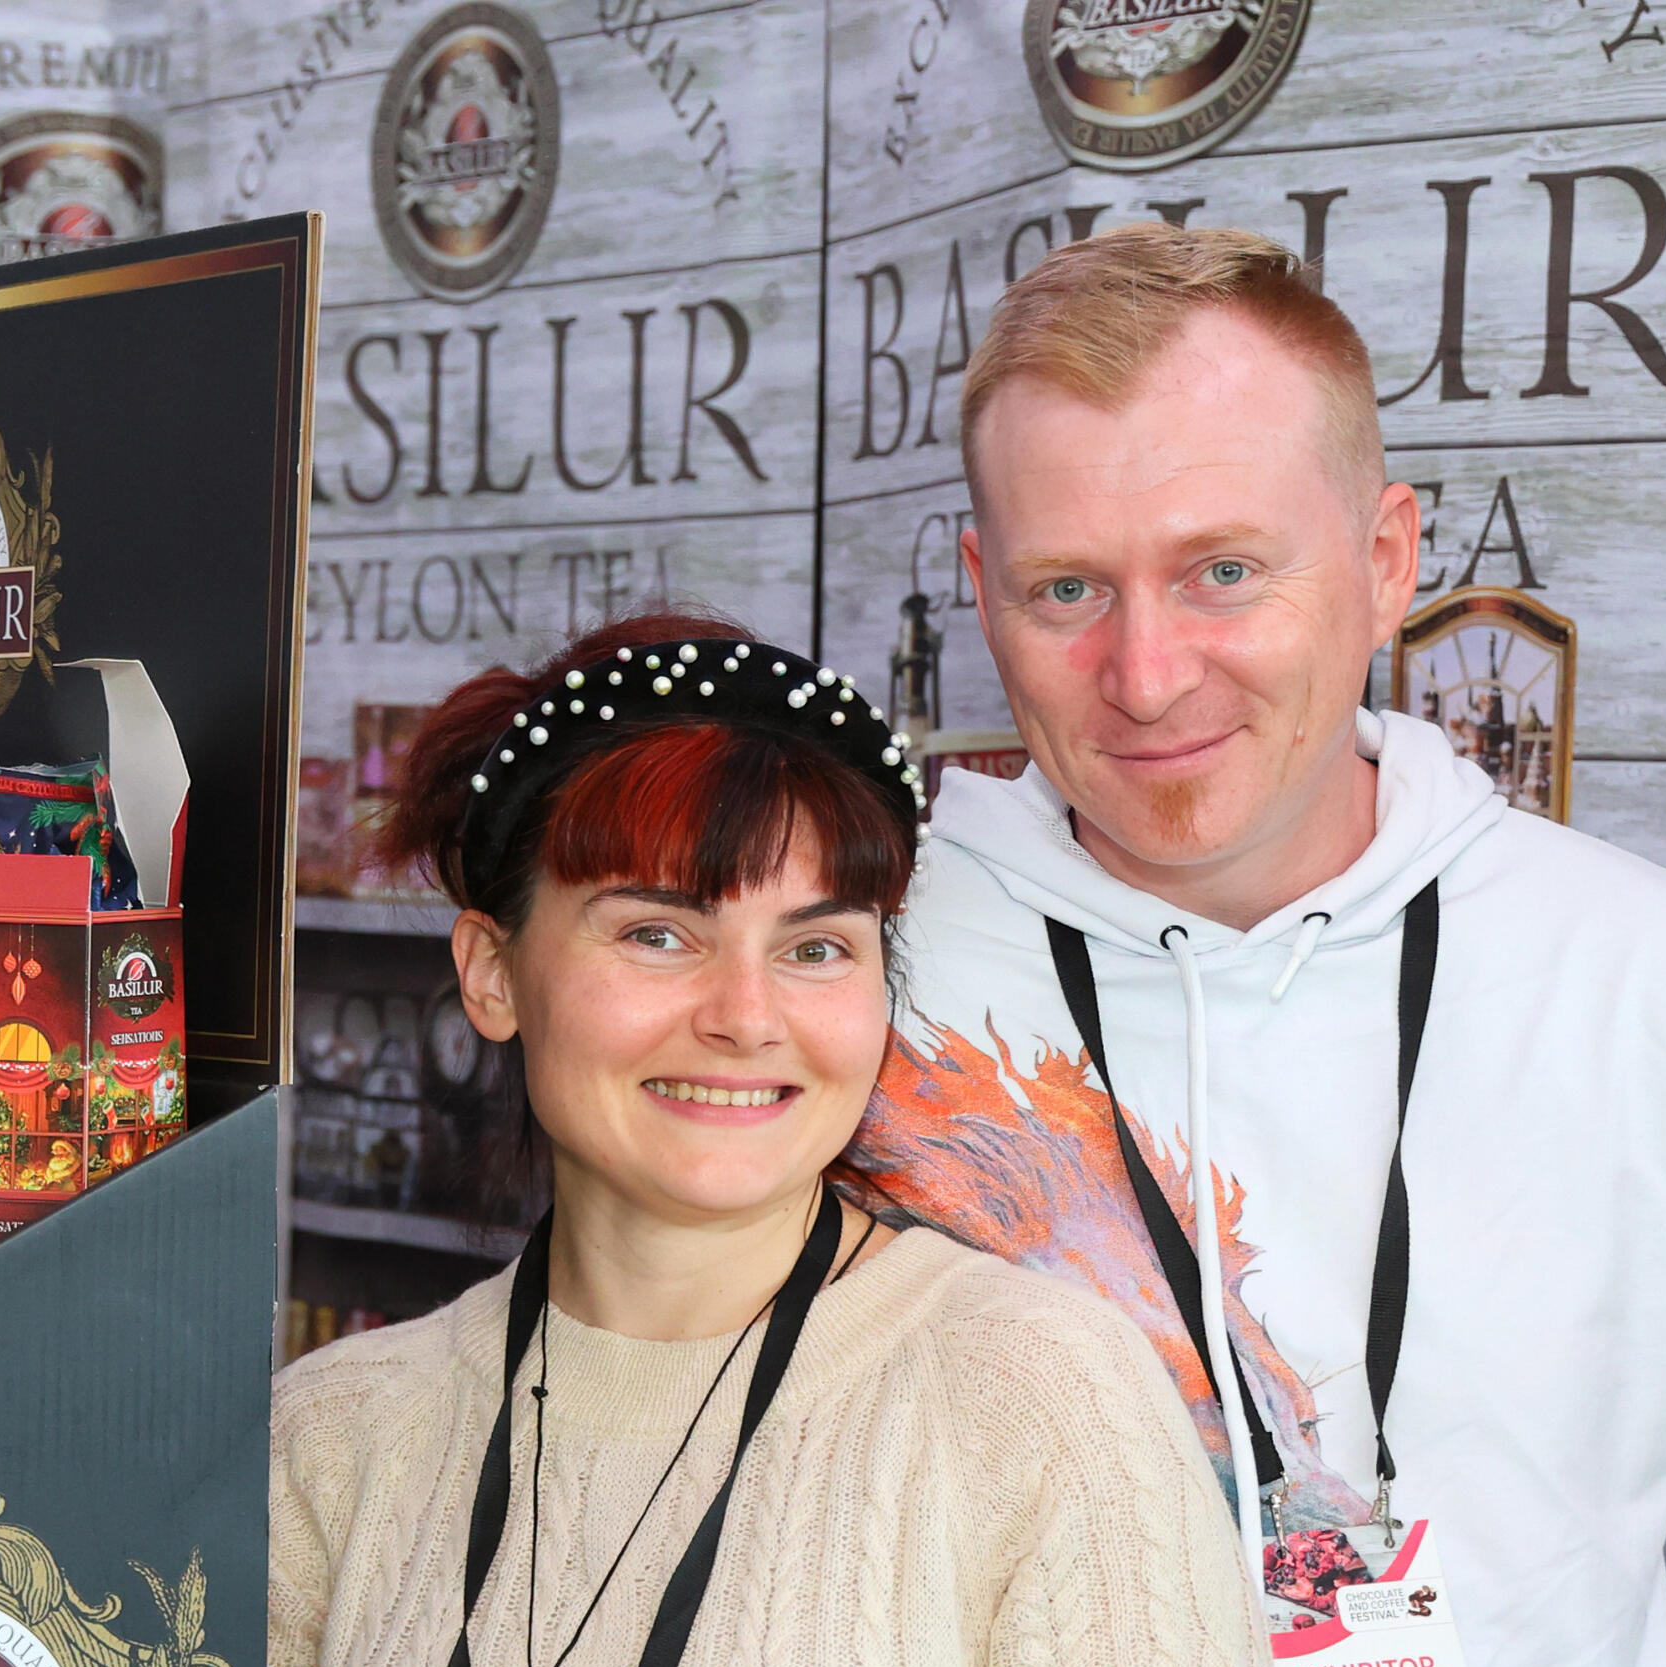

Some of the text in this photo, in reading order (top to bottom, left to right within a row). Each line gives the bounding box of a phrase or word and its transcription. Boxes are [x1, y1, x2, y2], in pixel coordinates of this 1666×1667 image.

[109, 978, 165, 999] BASILUR
[110, 1030, 164, 1046] SENSATIONS
[1345, 1588, 1405, 1602] CHOCOLATE
[1348, 1597, 1408, 1612] AND COFFEE
